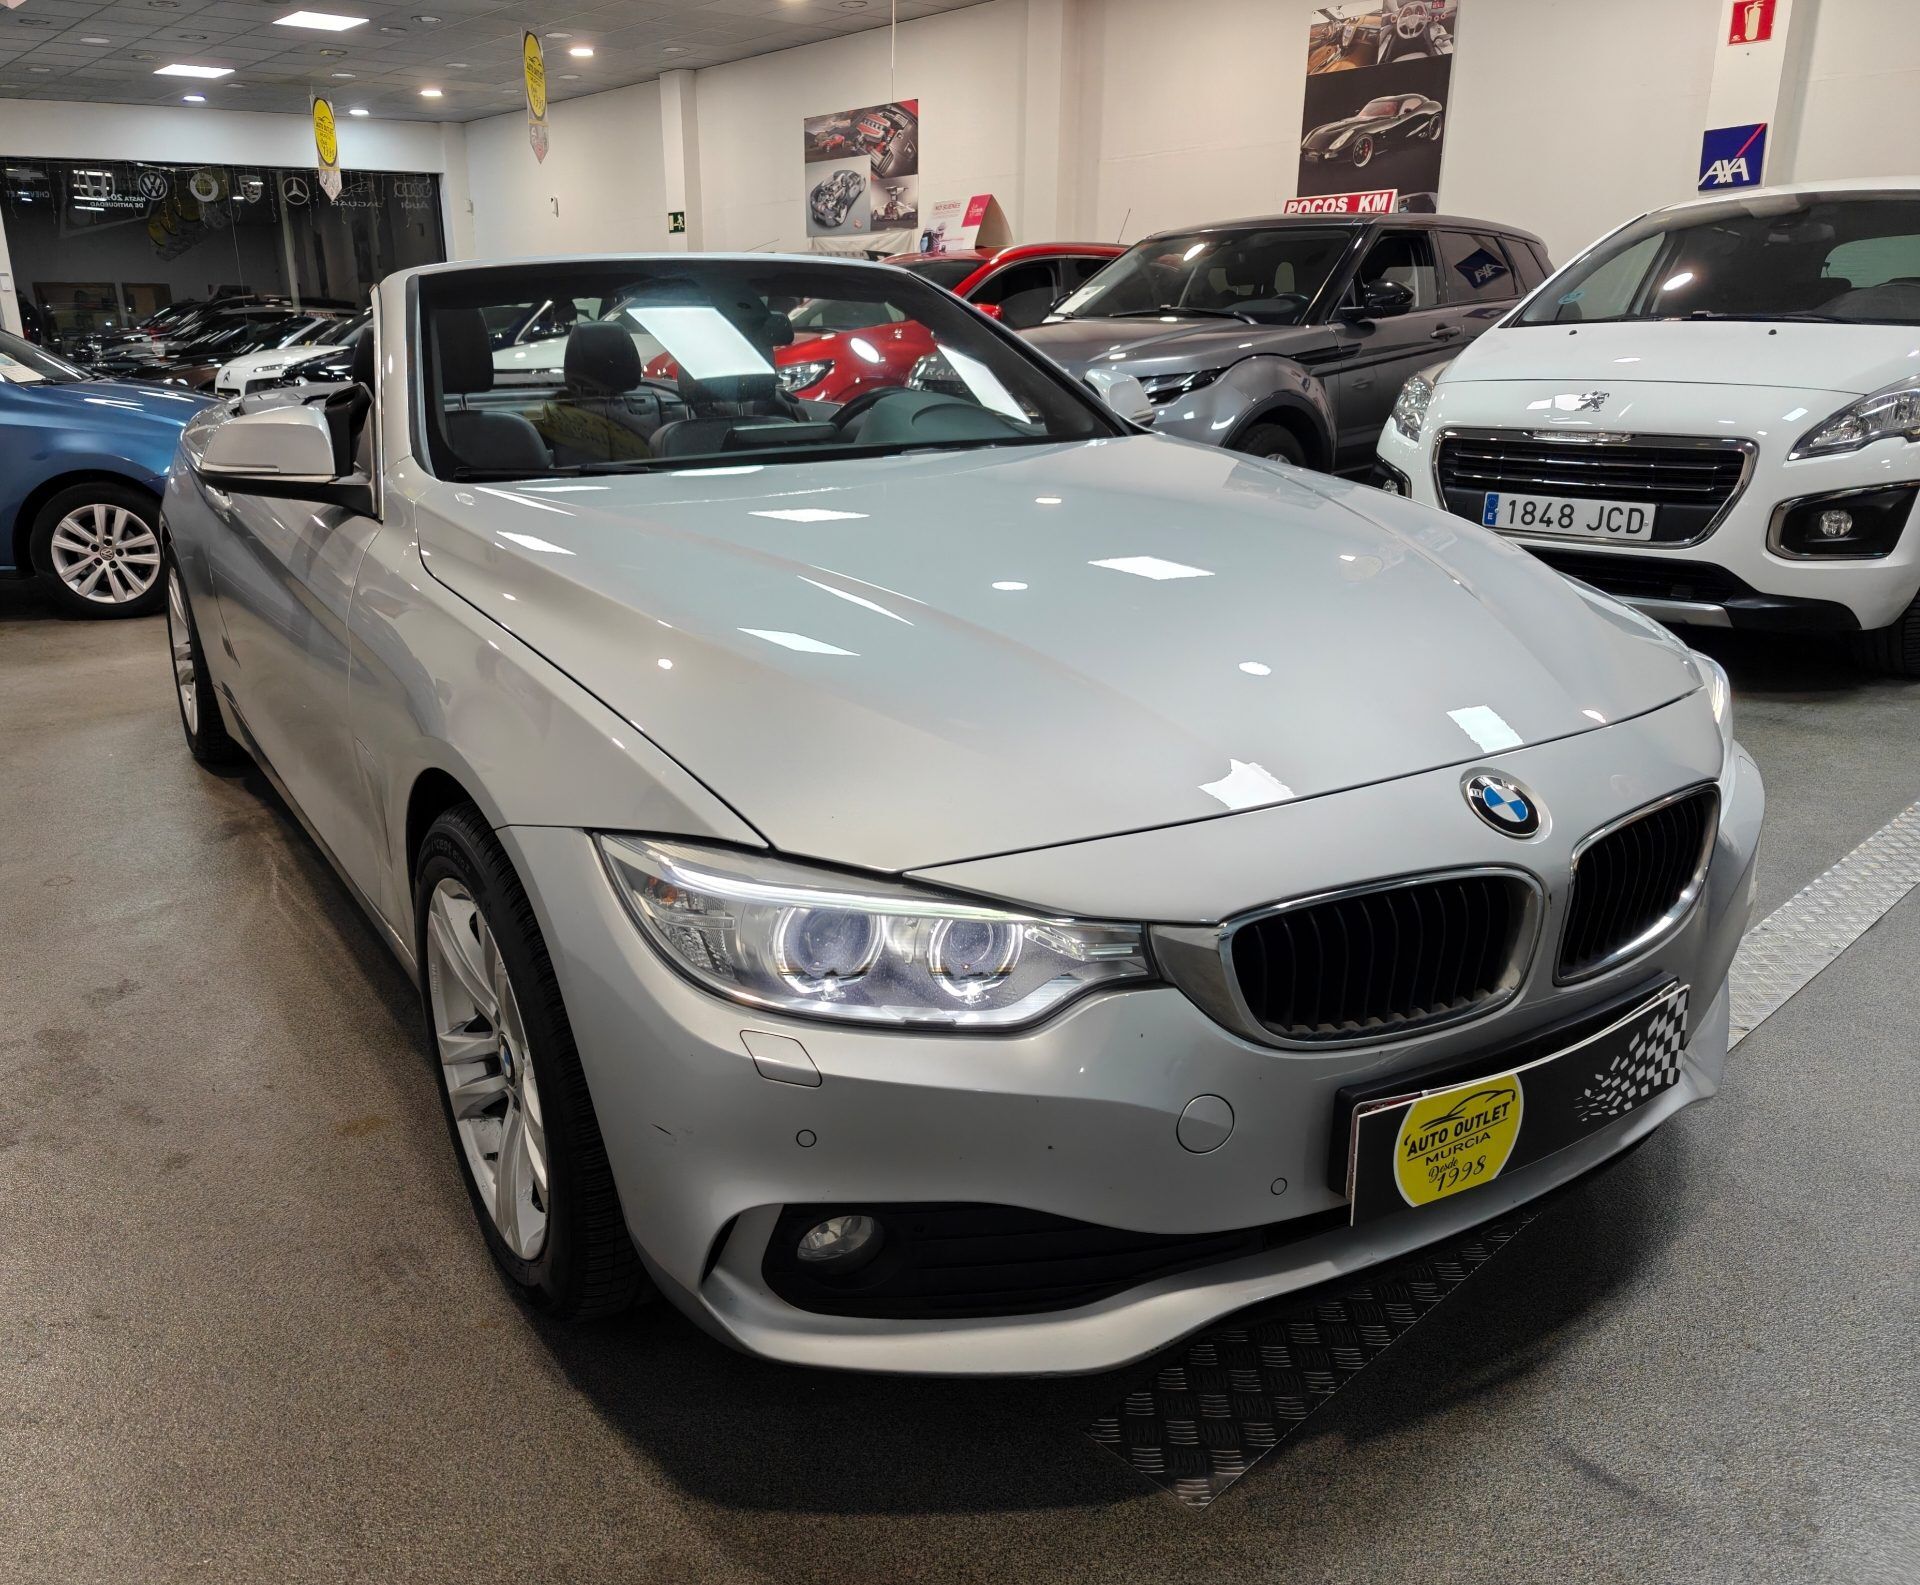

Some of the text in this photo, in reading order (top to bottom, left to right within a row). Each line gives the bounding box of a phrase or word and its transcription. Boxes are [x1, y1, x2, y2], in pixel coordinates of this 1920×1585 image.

[1699, 157, 1750, 186] AXA
[1287, 193, 1390, 213] POCOS KM
[1508, 499, 1646, 535] 1848 JCD
[1406, 1101, 1511, 1157] AUTO OUTLET
[1425, 1132, 1491, 1166] MURCIA
[1428, 1156, 1459, 1183] Desde
[1437, 1155, 1487, 1192] 1998
